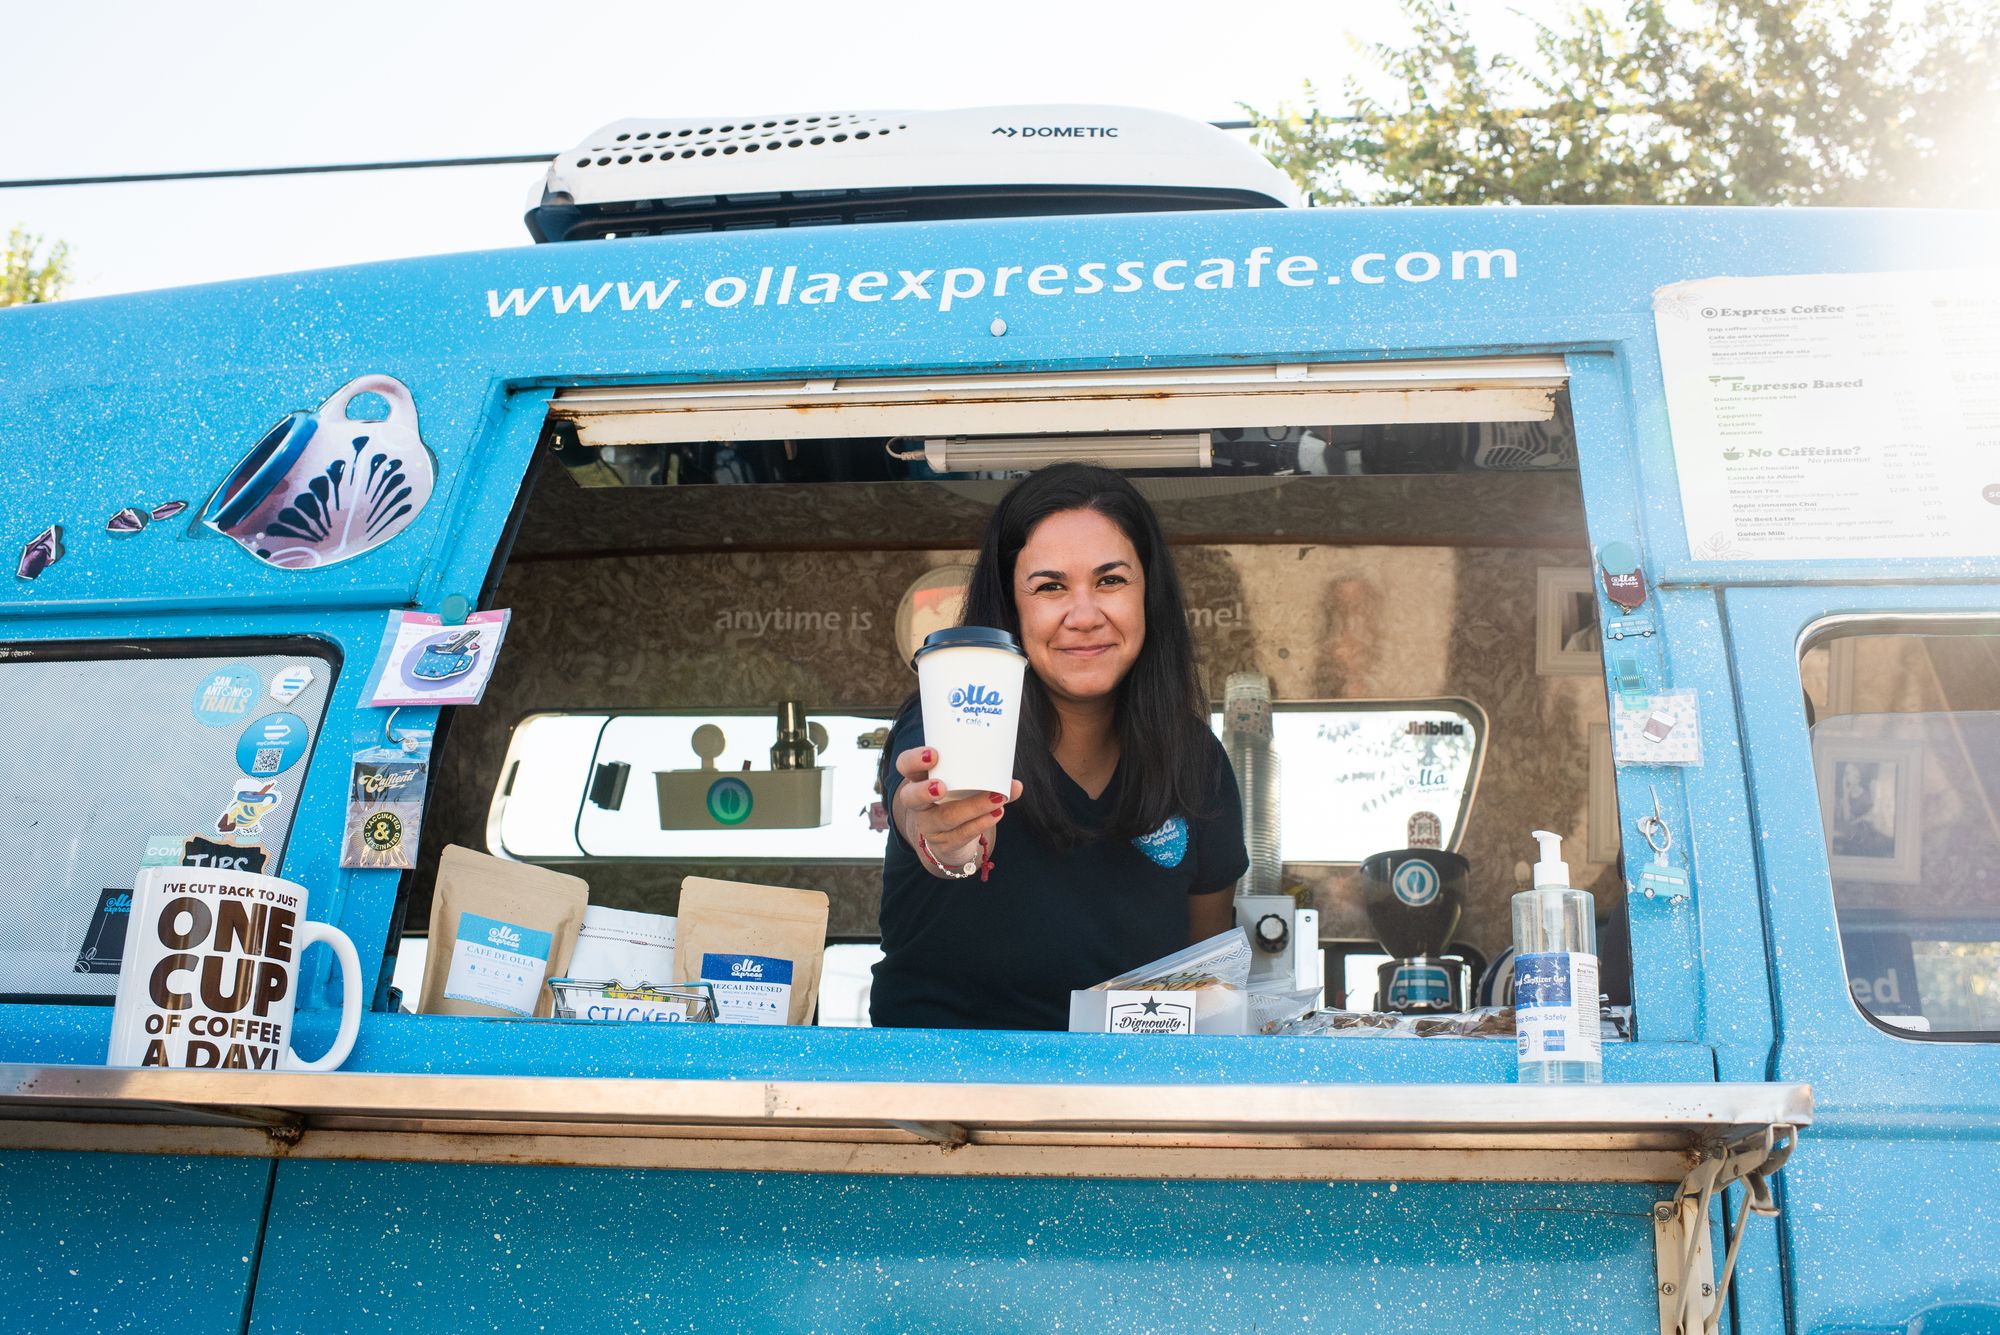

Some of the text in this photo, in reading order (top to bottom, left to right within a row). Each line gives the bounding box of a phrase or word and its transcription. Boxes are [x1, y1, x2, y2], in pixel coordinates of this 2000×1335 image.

[1022, 127, 1118, 137] DOMETIC
[486, 246, 1518, 317] www.ollaexpresscafe.com
[1720, 308, 1787, 317] Express
[1791, 304, 1846, 314] Coffee
[1731, 379, 1863, 392] Espresso Based
[1748, 446, 1861, 458] No Caffeine?
[715, 606, 873, 637] anytime is
[213, 675, 232, 686] SAN
[205, 686, 253, 697] ANTONIO
[200, 697, 248, 713] TRAILS
[963, 706, 1003, 716] express
[1405, 721, 1464, 735] Jiribilla
[365, 812, 401, 830] VACCINATED
[373, 821, 390, 841] &
[365, 832, 401, 851] CAFFEINATED
[1408, 838, 1440, 846] HANDS
[163, 883, 298, 908] I'VE CUT BACK TO JUST
[157, 896, 296, 963] ONE
[494, 951, 508, 960] DE
[509, 956, 534, 967] OLLA
[149, 953, 288, 1017] CUP
[746, 984, 782, 993] INFUSED
[145, 1013, 282, 1045] OF COFFEE
[1119, 1016, 1181, 1033] Dignowity
[141, 1039, 279, 1070] A DAY!
